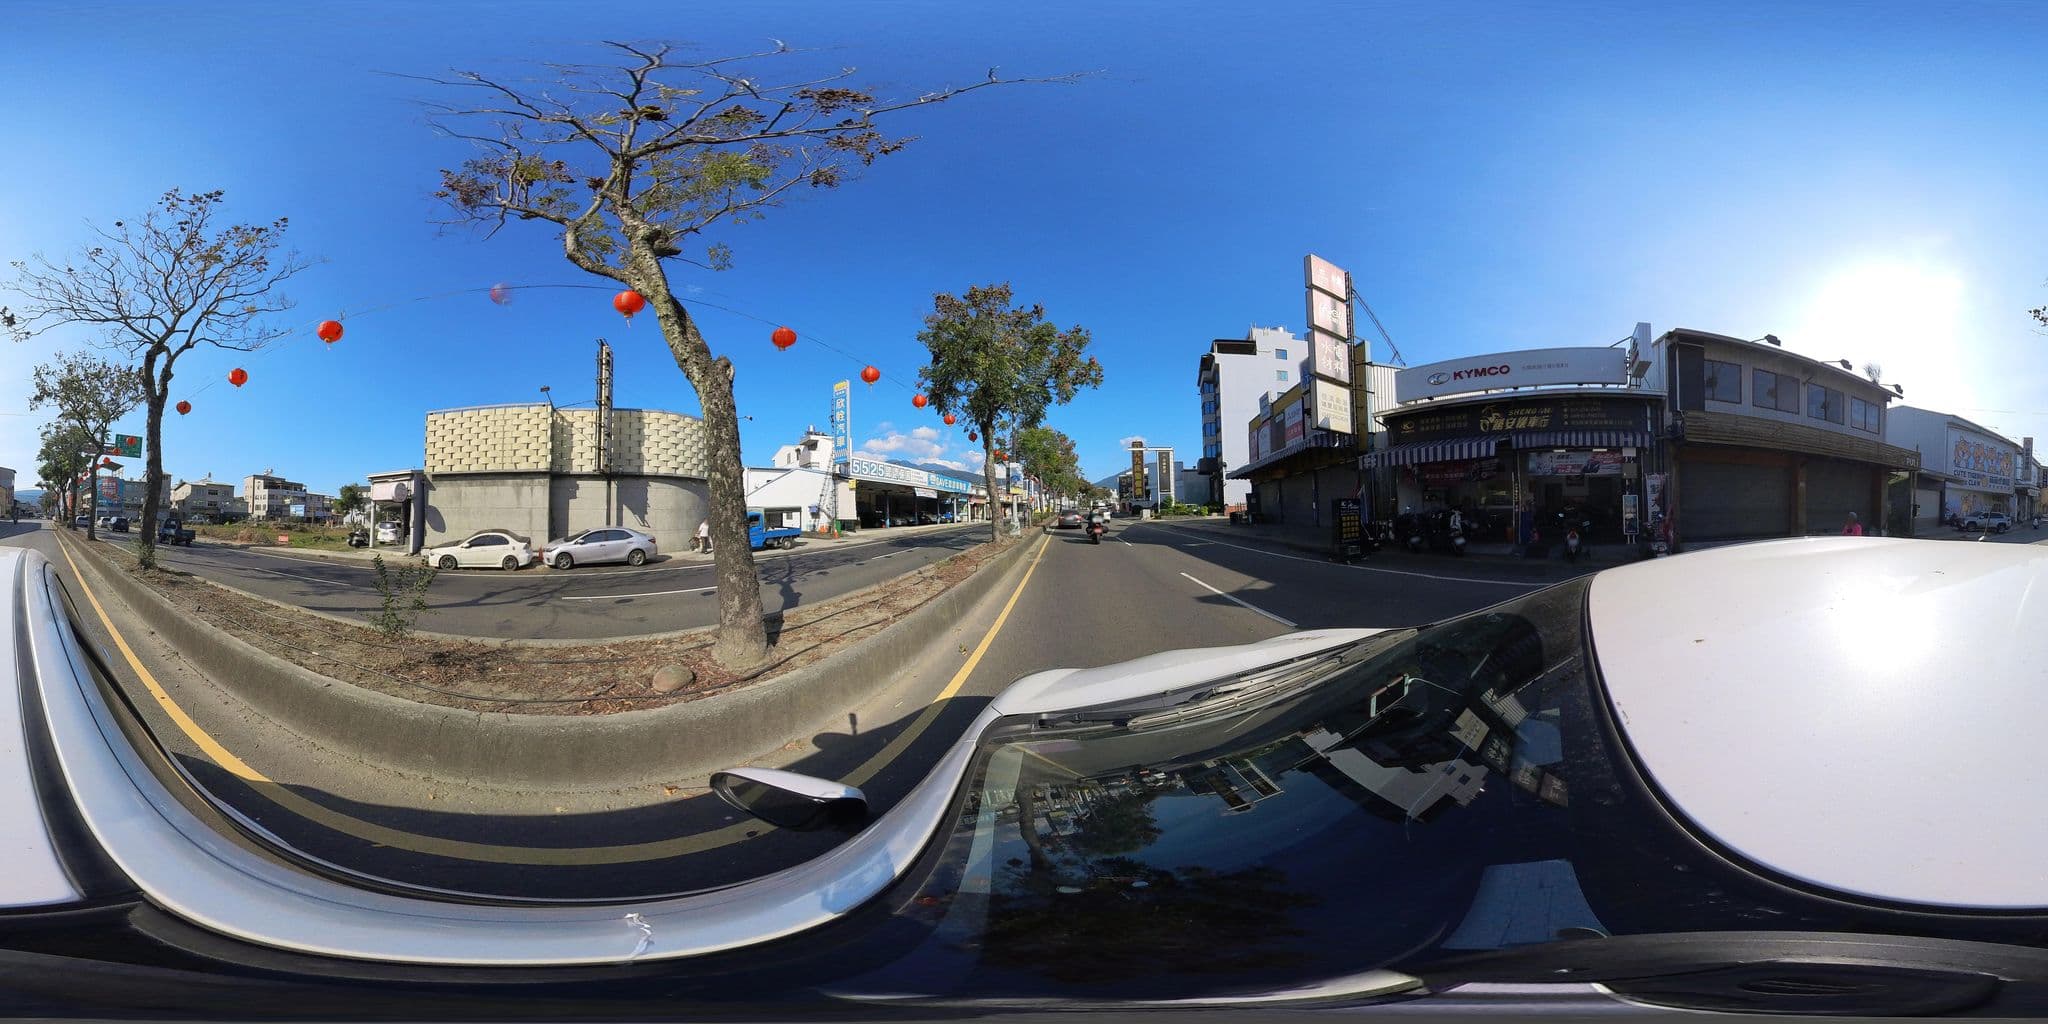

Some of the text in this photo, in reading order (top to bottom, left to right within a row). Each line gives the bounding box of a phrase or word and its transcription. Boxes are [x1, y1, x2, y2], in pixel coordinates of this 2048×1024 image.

[1453, 365, 1510, 380] KYMCO
[852, 460, 884, 477] 5525
[1953, 469, 1966, 478] CUTE
